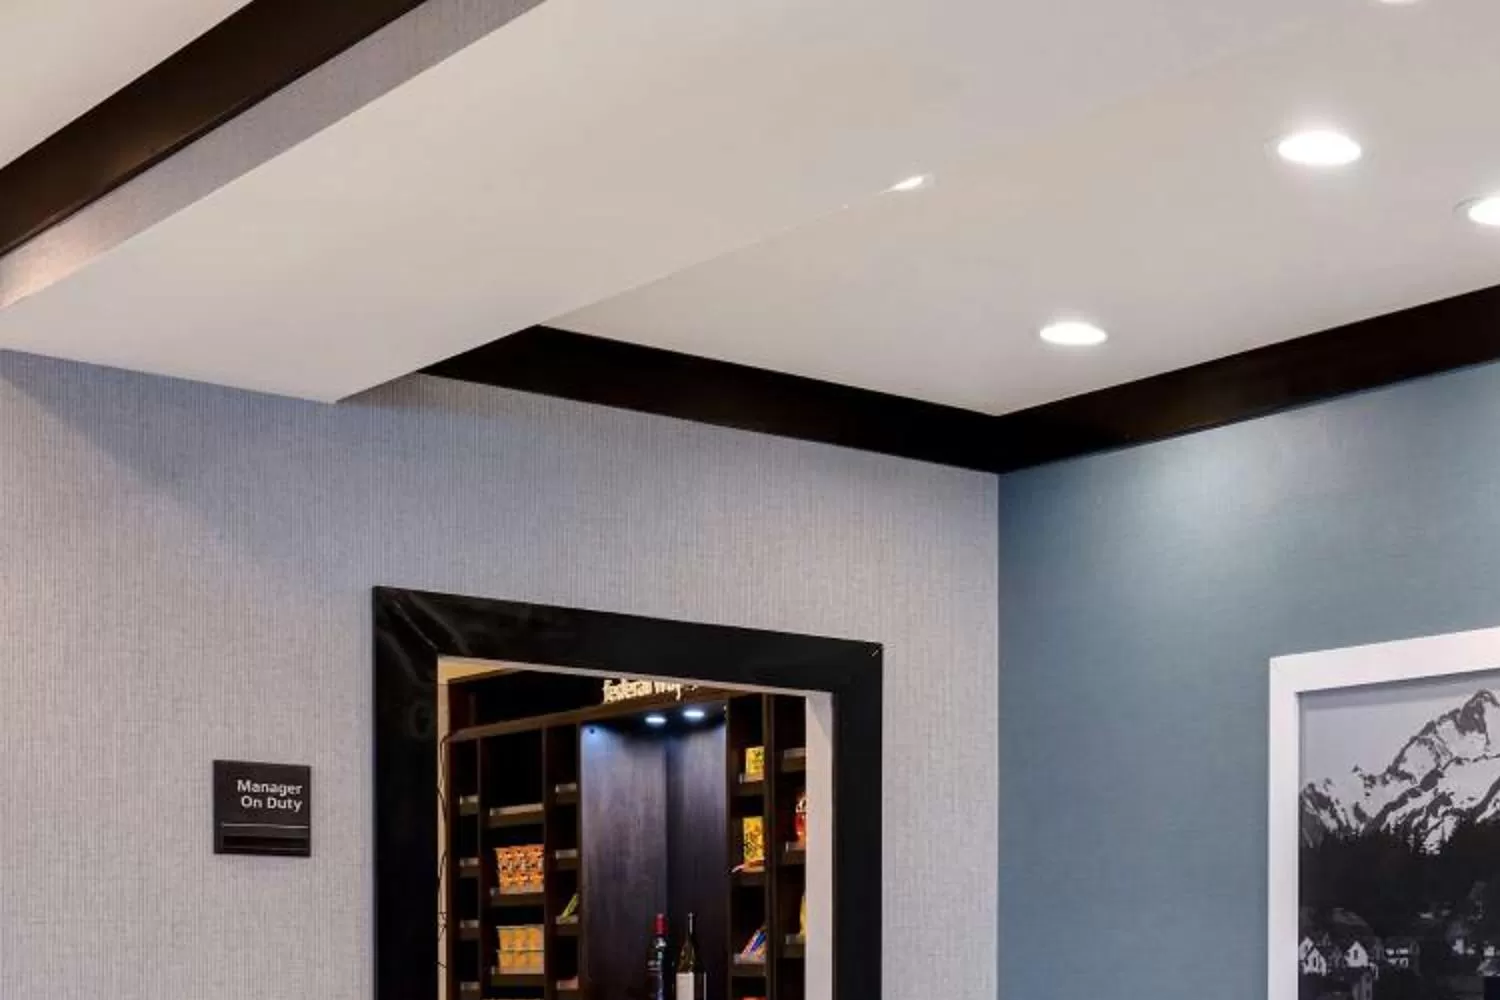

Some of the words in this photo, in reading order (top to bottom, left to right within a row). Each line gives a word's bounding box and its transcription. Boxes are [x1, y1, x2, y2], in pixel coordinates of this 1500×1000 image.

[237, 779, 303, 796] Manager
[241, 795, 263, 808] On
[267, 796, 303, 813] Duty
